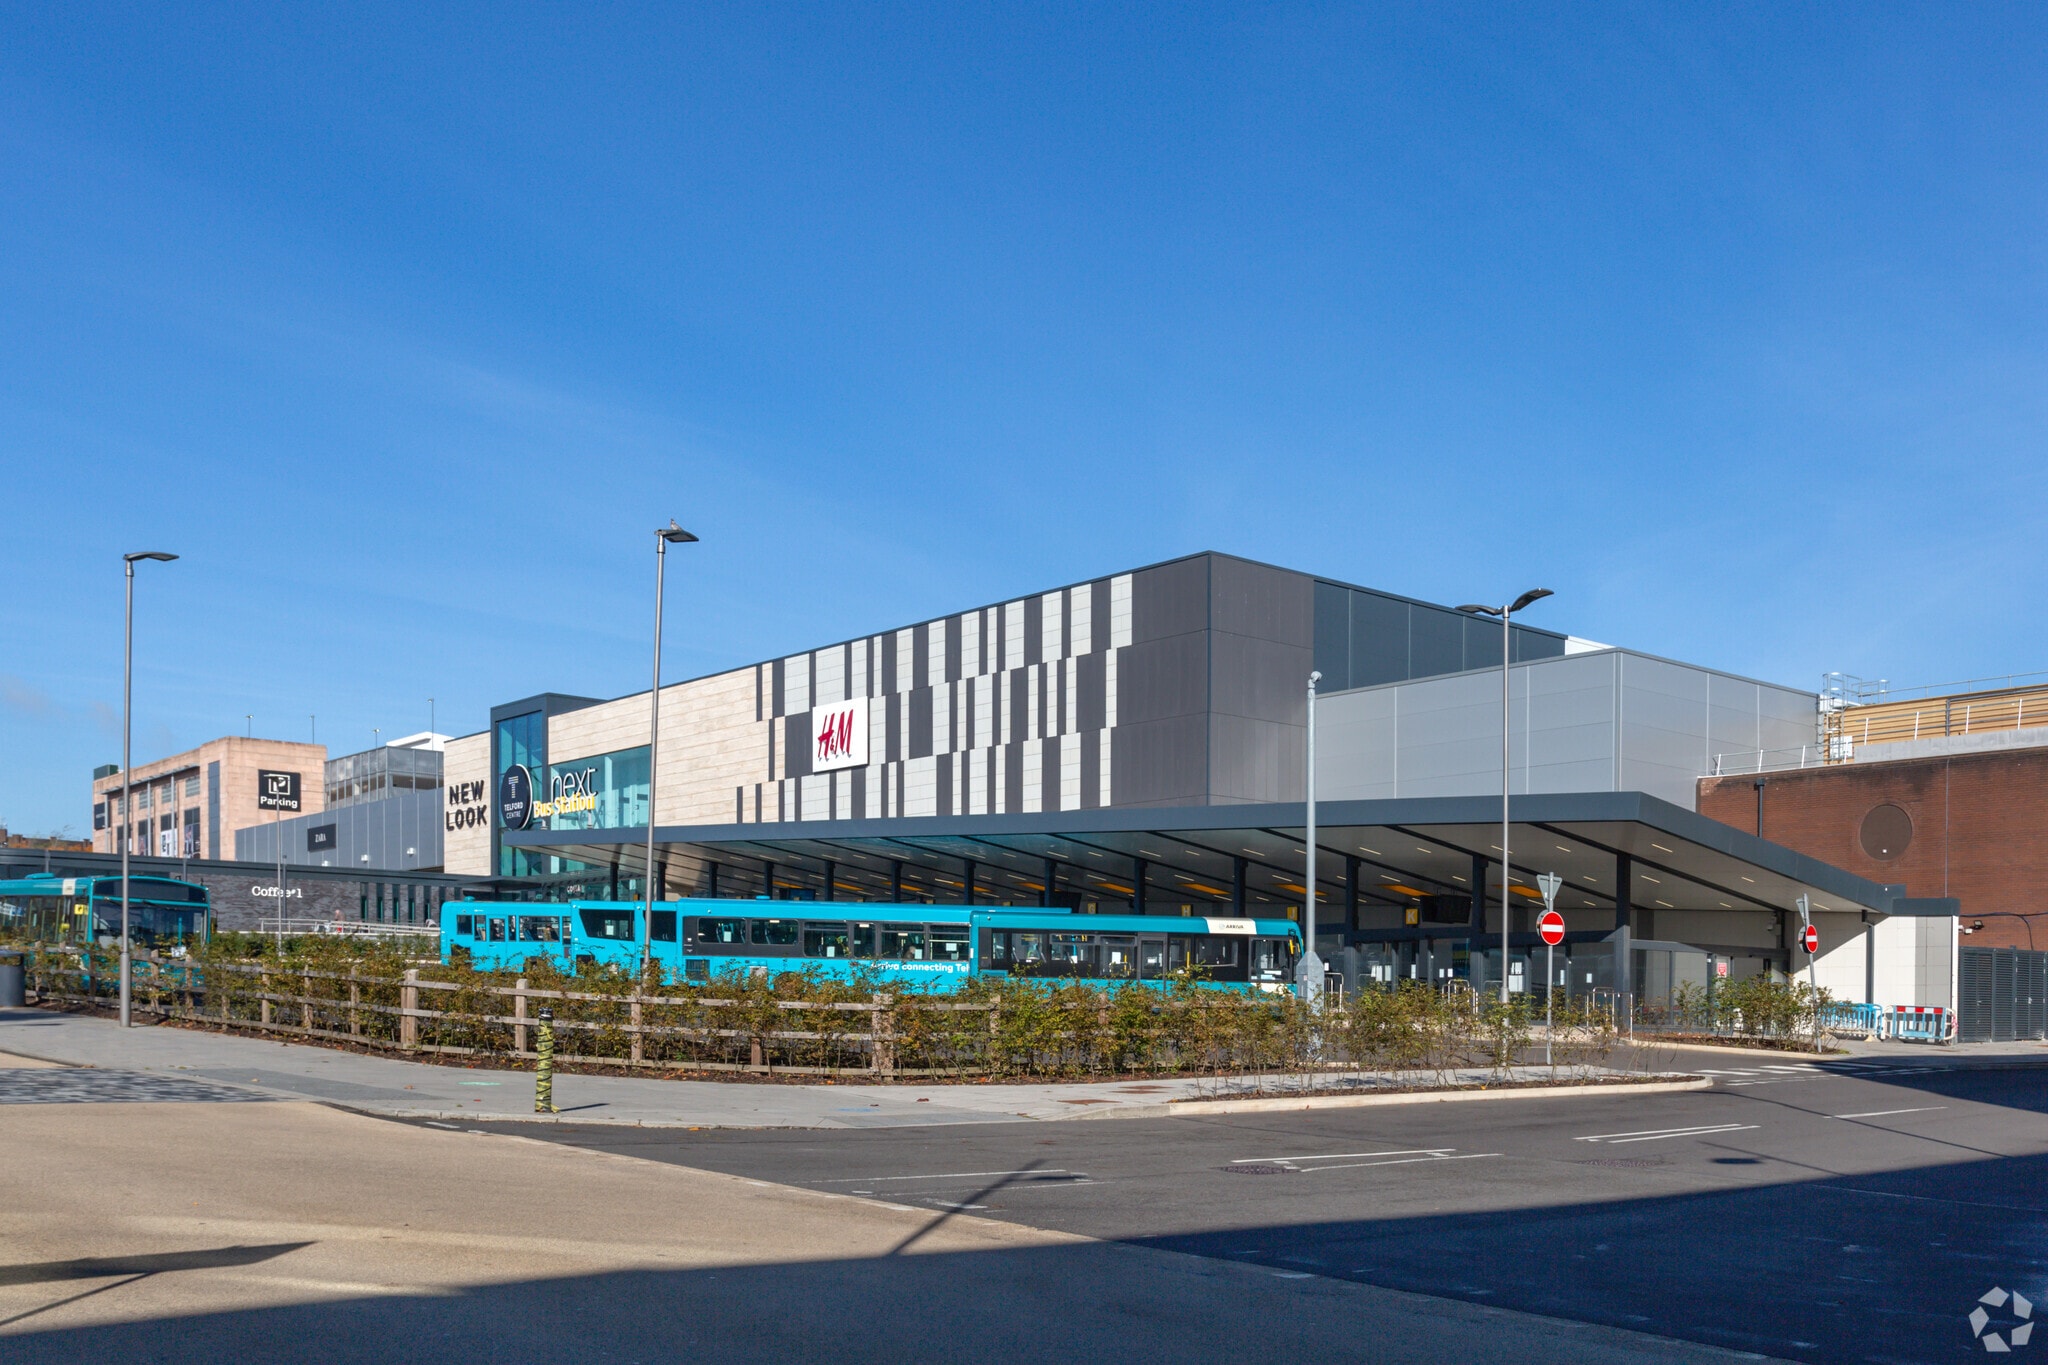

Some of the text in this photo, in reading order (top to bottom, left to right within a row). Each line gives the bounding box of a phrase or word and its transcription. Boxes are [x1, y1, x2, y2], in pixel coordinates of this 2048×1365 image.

[817, 709, 853, 759] H&M
[449, 780, 485, 806] NEW
[551, 767, 597, 803] next
[504, 801, 524, 811] TELFORD
[506, 810, 521, 819] CENTRE
[533, 792, 595, 818] Bus Station
[446, 805, 487, 832] LOOK
[315, 833, 326, 842] ZARA
[1408, 911, 1415, 922] K
[901, 962, 954, 974] connecting
